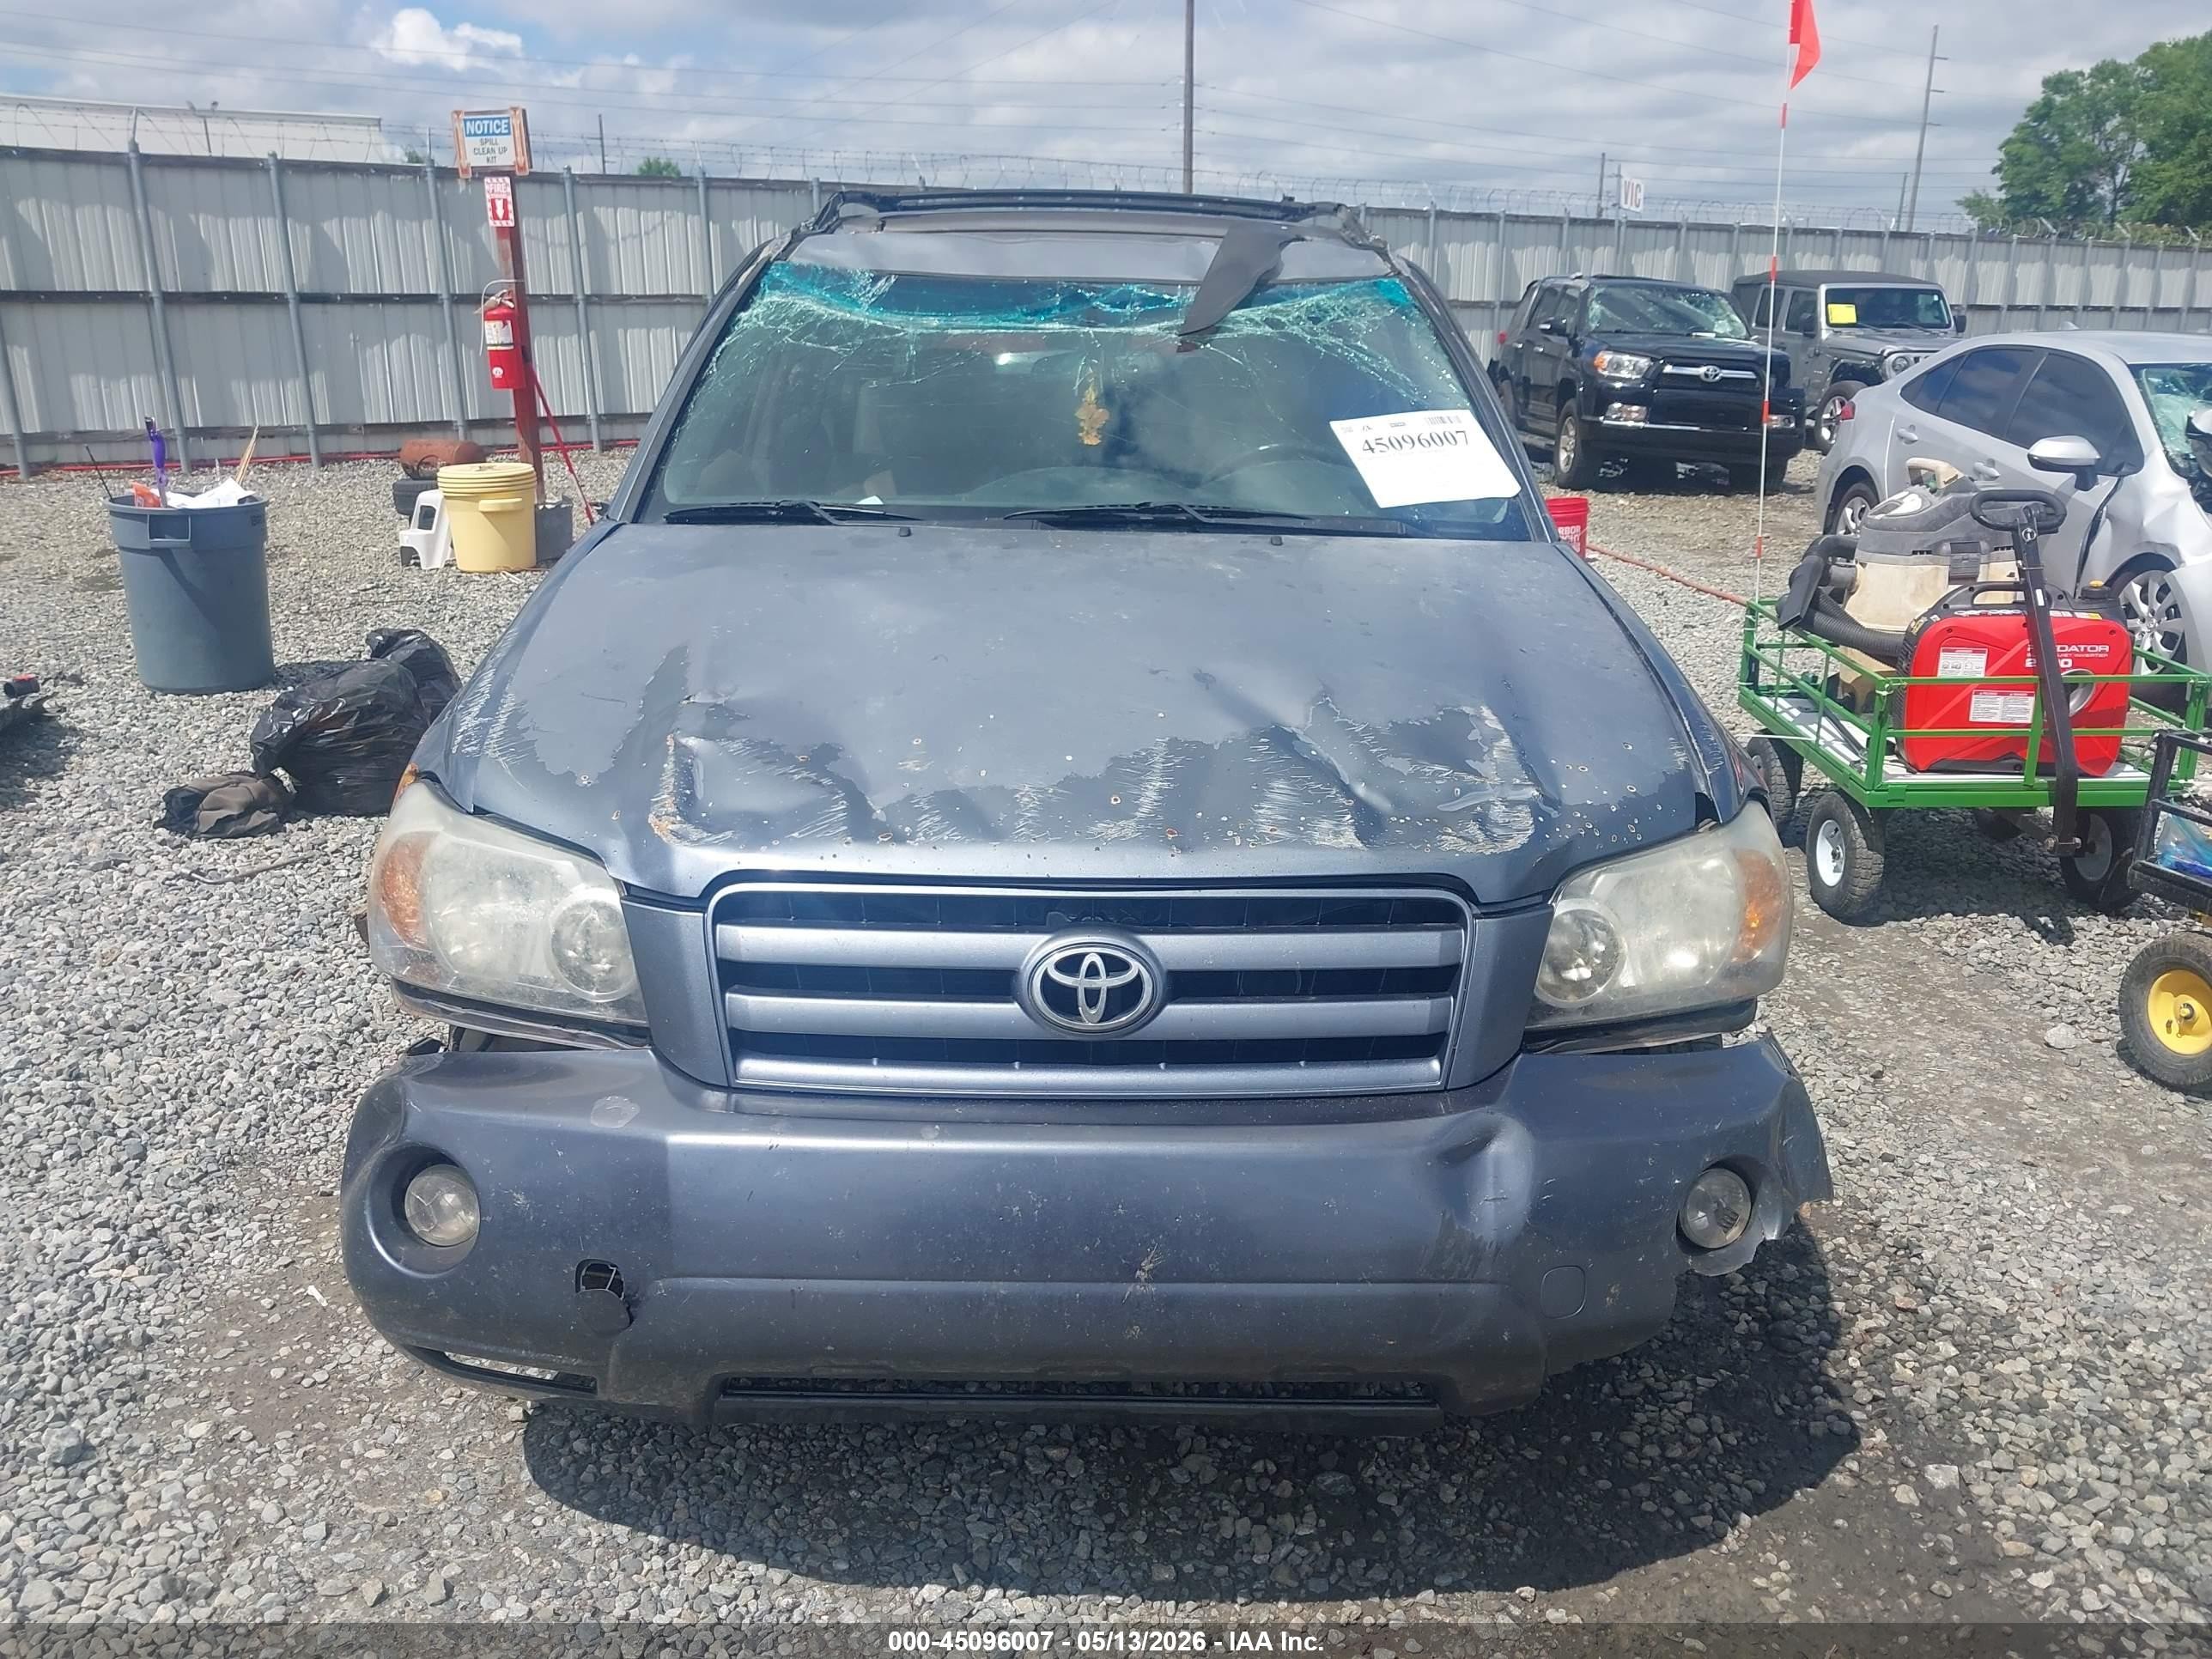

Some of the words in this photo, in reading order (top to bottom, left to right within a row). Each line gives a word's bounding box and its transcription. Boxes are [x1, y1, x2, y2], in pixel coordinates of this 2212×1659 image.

[465, 119, 509, 135] NOTICE
[473, 148, 495, 156] CLEAN
[489, 183, 508, 193] FIRE
[1363, 430, 1468, 454] 45096007
